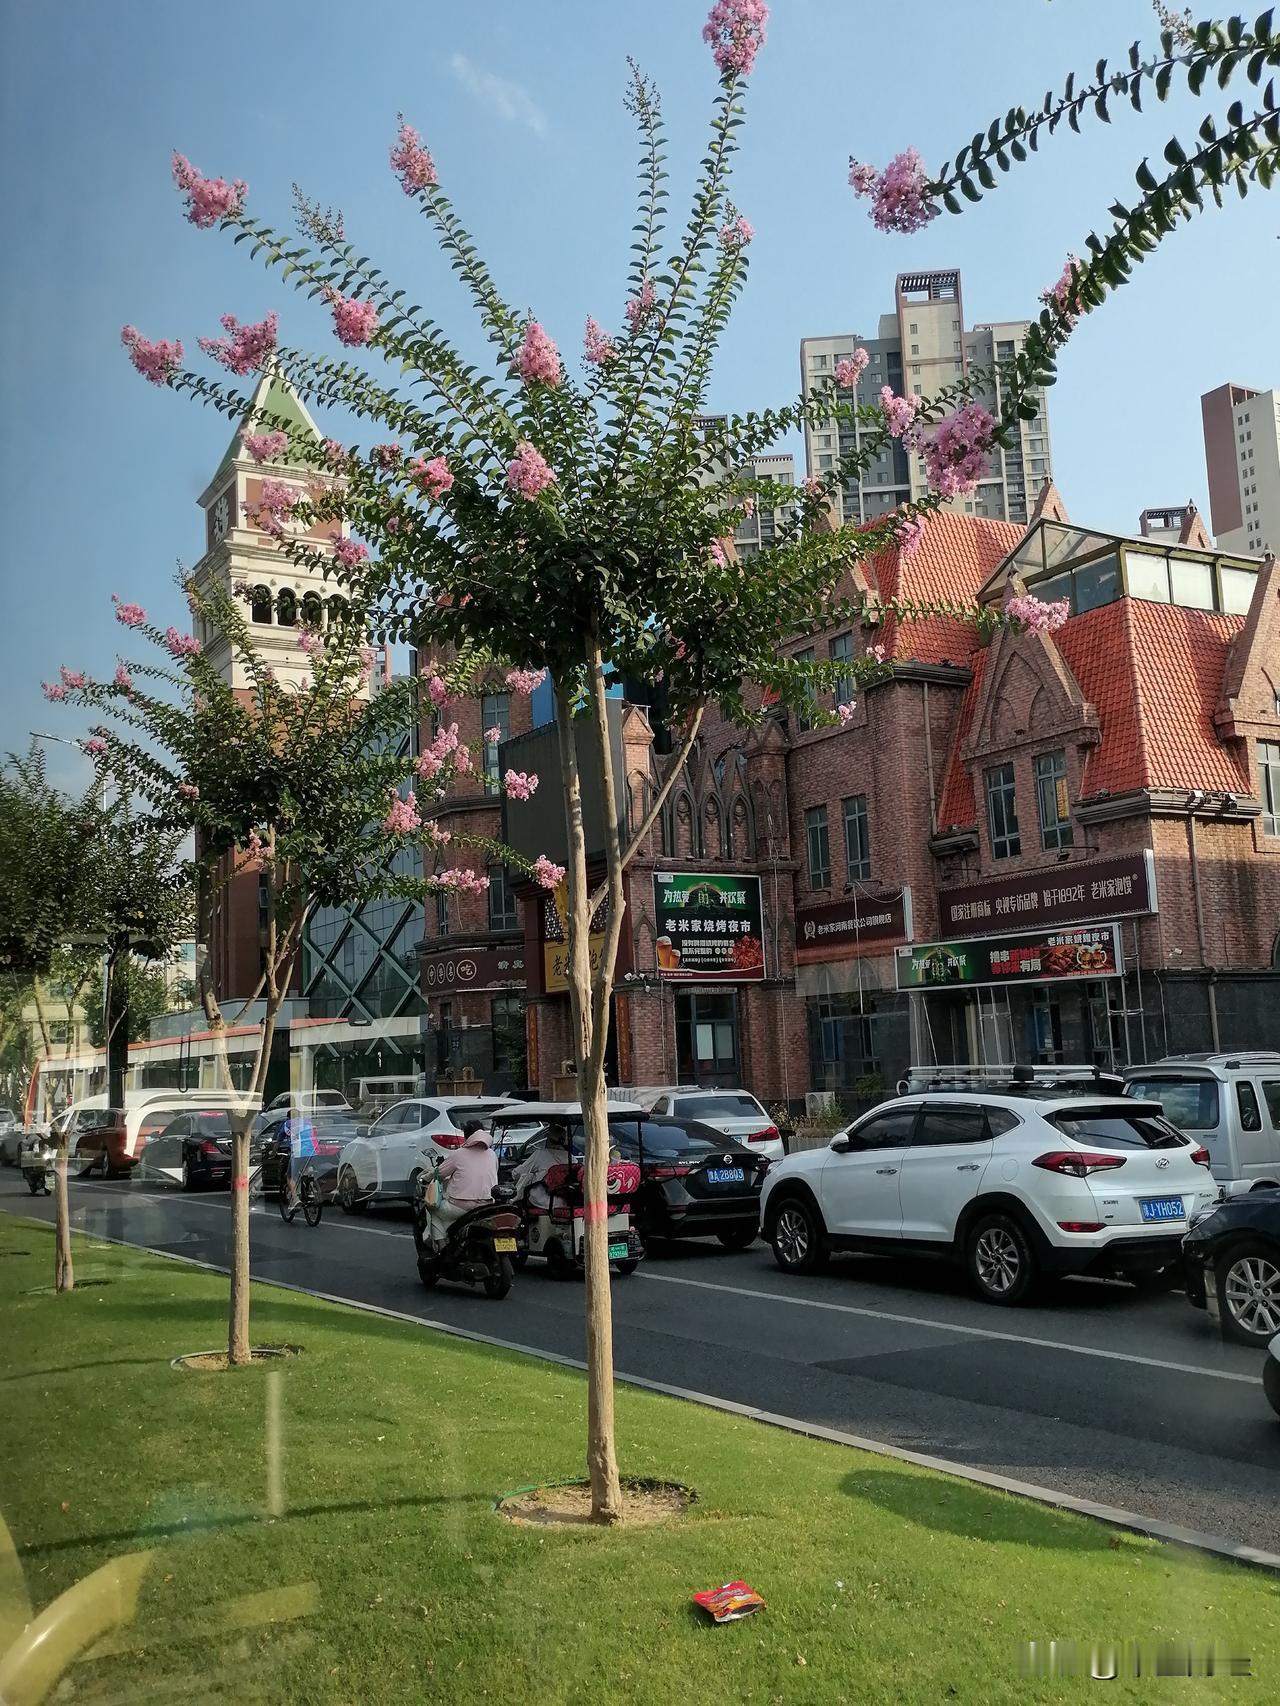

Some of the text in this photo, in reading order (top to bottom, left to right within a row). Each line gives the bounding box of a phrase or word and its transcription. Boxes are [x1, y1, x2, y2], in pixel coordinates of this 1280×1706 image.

[663, 889, 747, 904] 为热爱 共欢聚
[950, 900, 992, 921] 国家注册商标
[995, 892, 1039, 915] 央视专访品牌
[1043, 884, 1086, 907] 始于1892年
[665, 919, 751, 933] 老米家烧烤夜市
[1047, 931, 1110, 947] 老米家烧烤夜市
